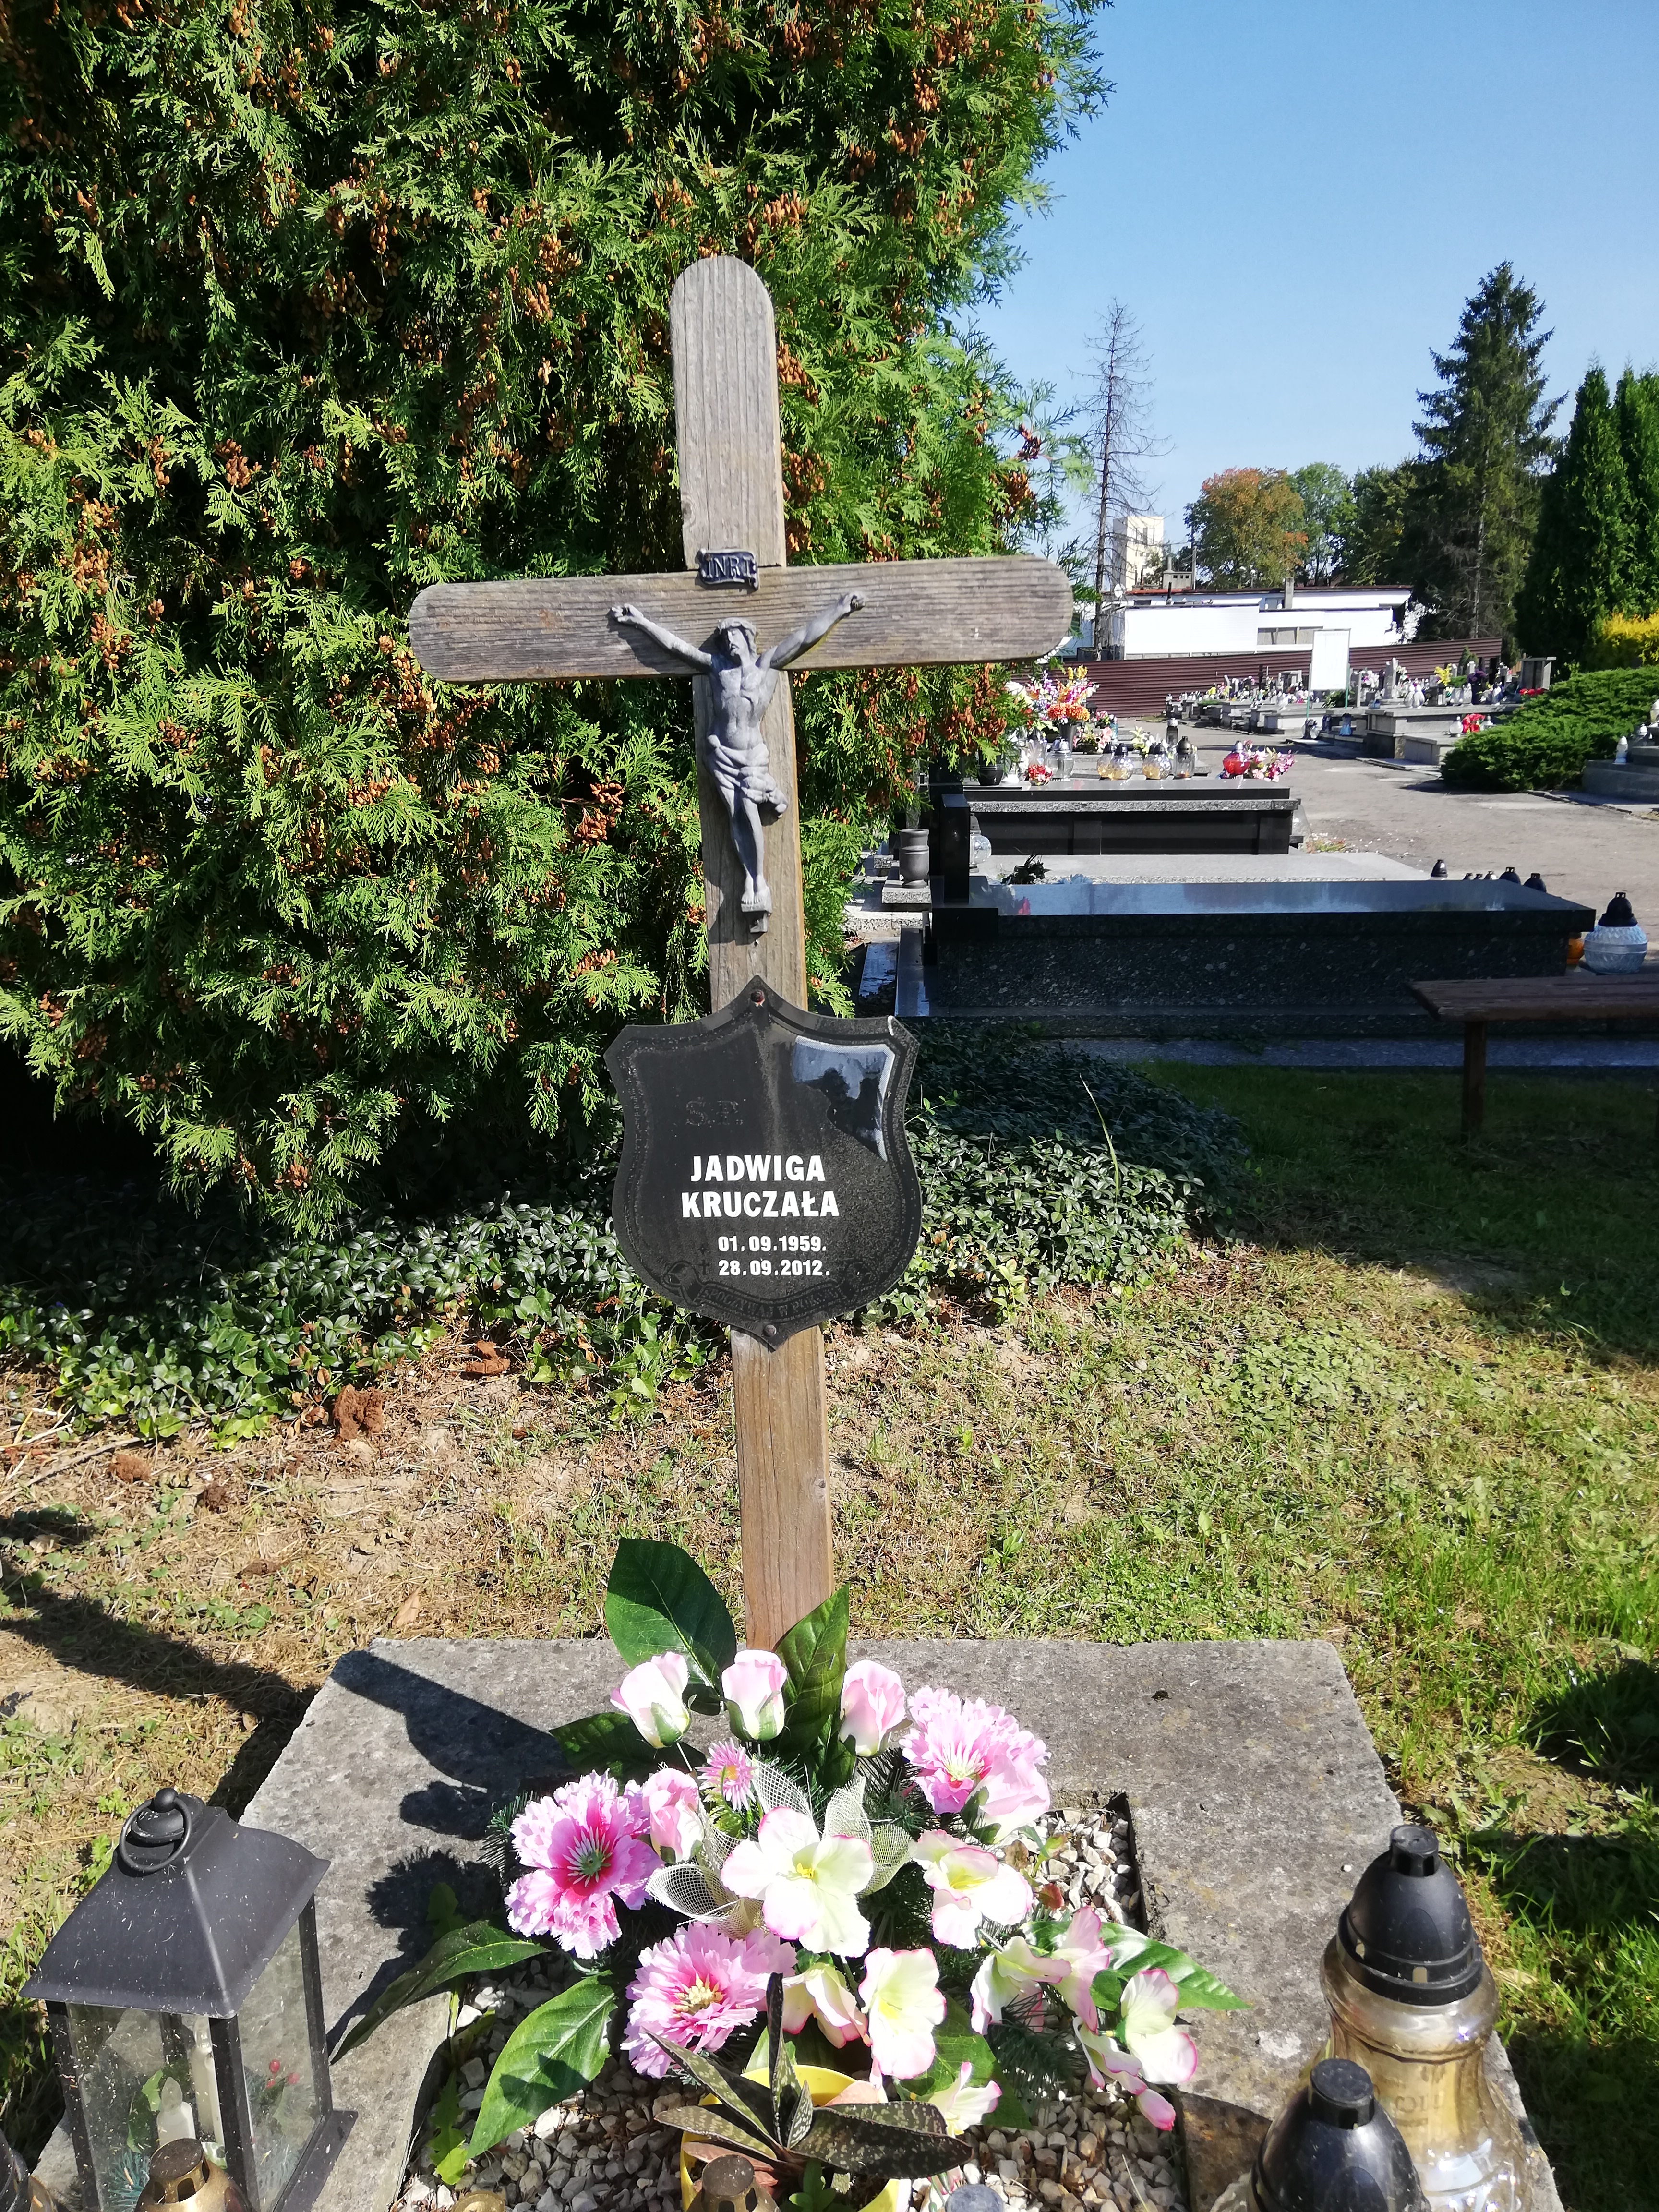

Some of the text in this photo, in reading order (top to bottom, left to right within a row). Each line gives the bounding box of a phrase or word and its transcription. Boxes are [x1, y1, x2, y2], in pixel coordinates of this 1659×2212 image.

[706, 555, 754, 578] INRI
[691, 1154, 826, 1182] JADWIGA
[681, 1190, 840, 1218] KRUCZAŁA
[718, 1235, 826, 1252] 01.09.1959.
[718, 1259, 830, 1276] 28.09.2012.
